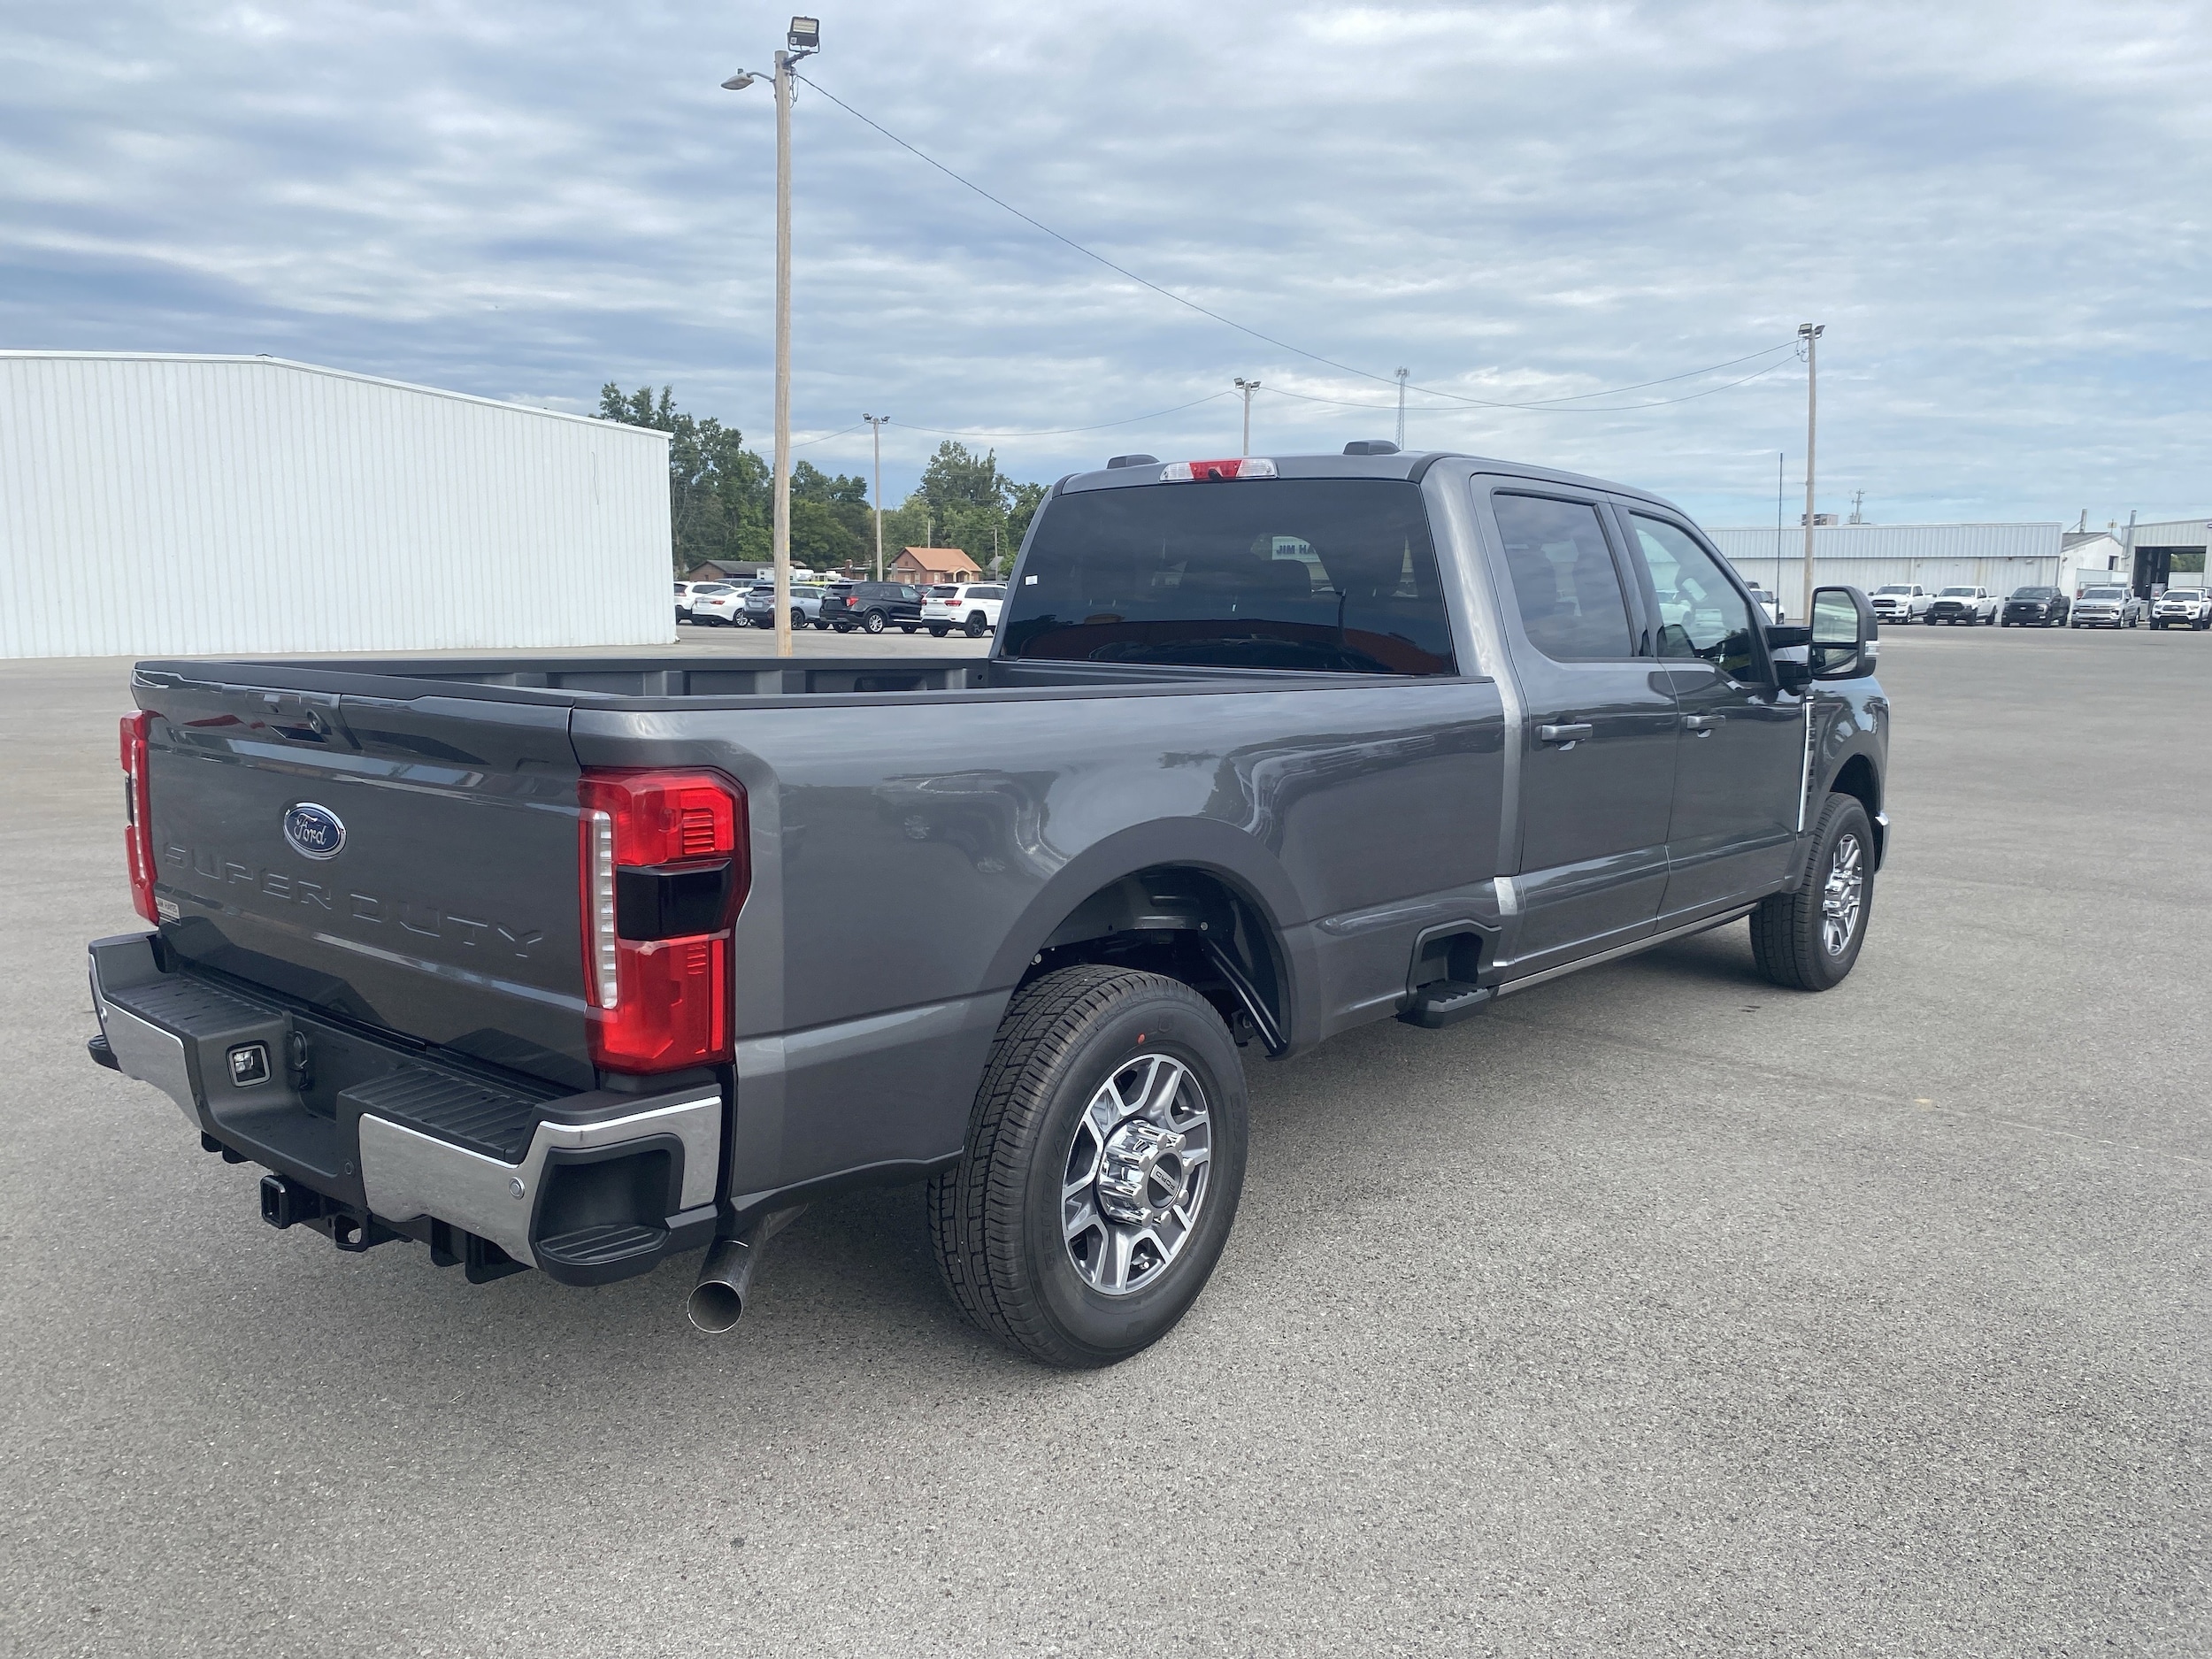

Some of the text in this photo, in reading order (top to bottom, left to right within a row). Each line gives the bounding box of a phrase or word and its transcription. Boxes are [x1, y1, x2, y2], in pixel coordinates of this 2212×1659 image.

[1276, 544, 1295, 555] JIM
[293, 812, 327, 846] Ford
[162, 842, 545, 958] SUPER DUTY
[1156, 1171, 1176, 1191] FORD
